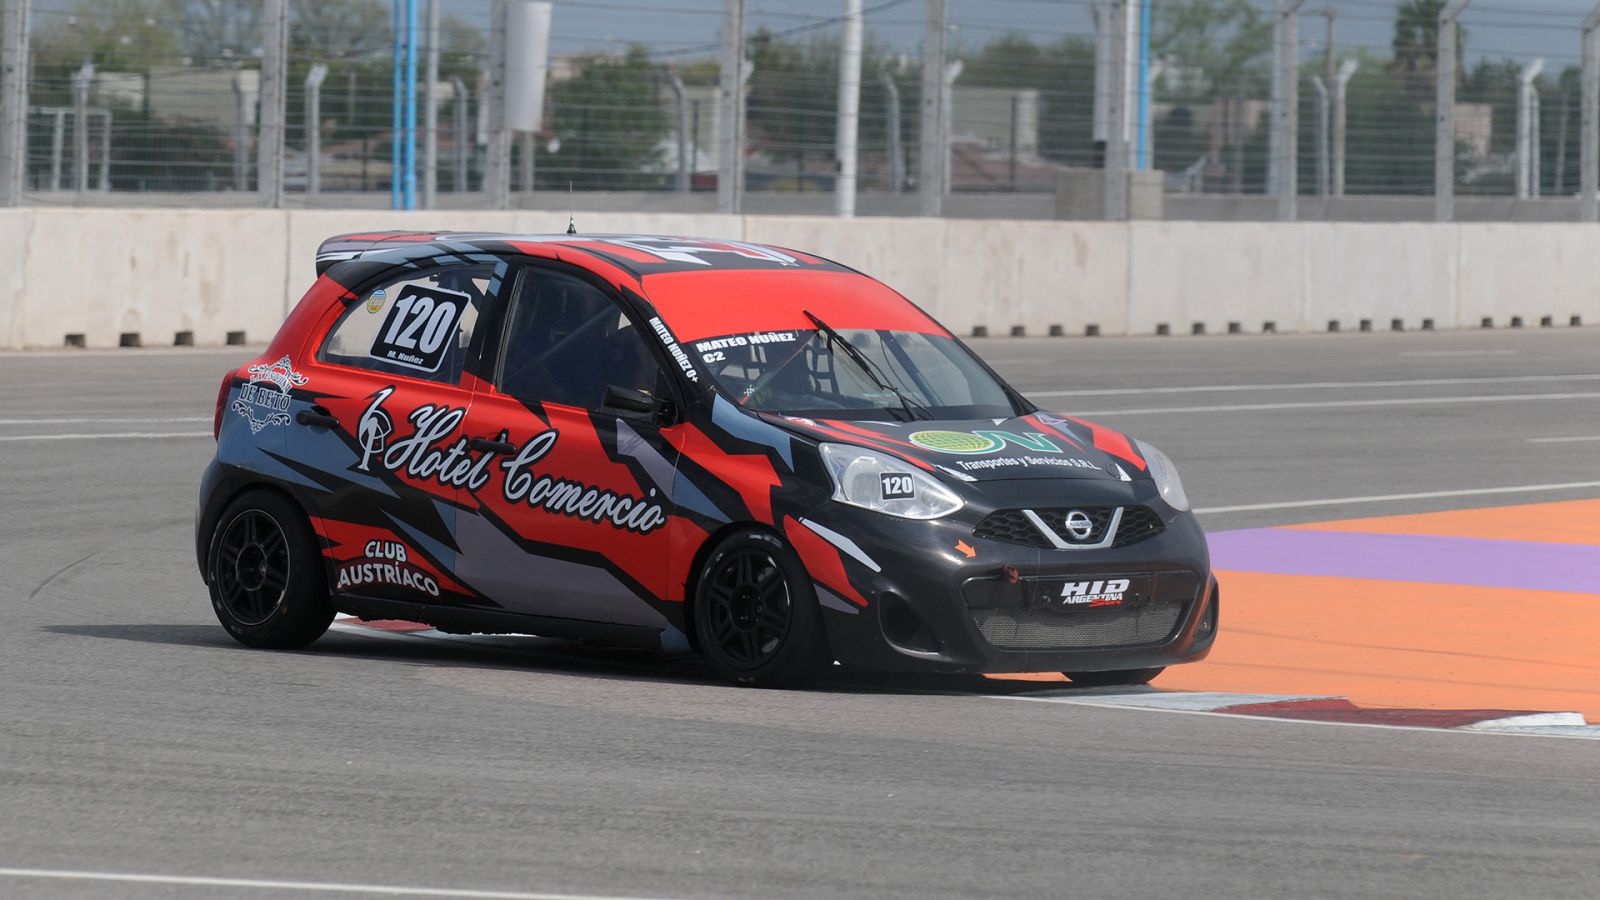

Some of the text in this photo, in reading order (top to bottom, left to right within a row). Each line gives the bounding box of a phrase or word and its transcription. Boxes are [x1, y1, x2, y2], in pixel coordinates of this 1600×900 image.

[384, 294, 456, 353] 120
[649, 316, 674, 345] MATEO
[667, 343, 693, 371] NUÑEZ
[696, 332, 796, 353] MATEO NUÑEZ
[387, 350, 424, 365] M. Nuñez
[703, 351, 726, 363] C2
[239, 383, 292, 412] DE BETO
[384, 405, 665, 531] Hotel Comercio
[956, 457, 1019, 470] Transportes
[1018, 457, 1028, 467] y
[1024, 456, 1069, 467] Servicios
[882, 476, 912, 494] 120
[365, 541, 407, 562] CLUB
[1061, 579, 1130, 596] HID
[1063, 592, 1123, 604] ARGENTINA
